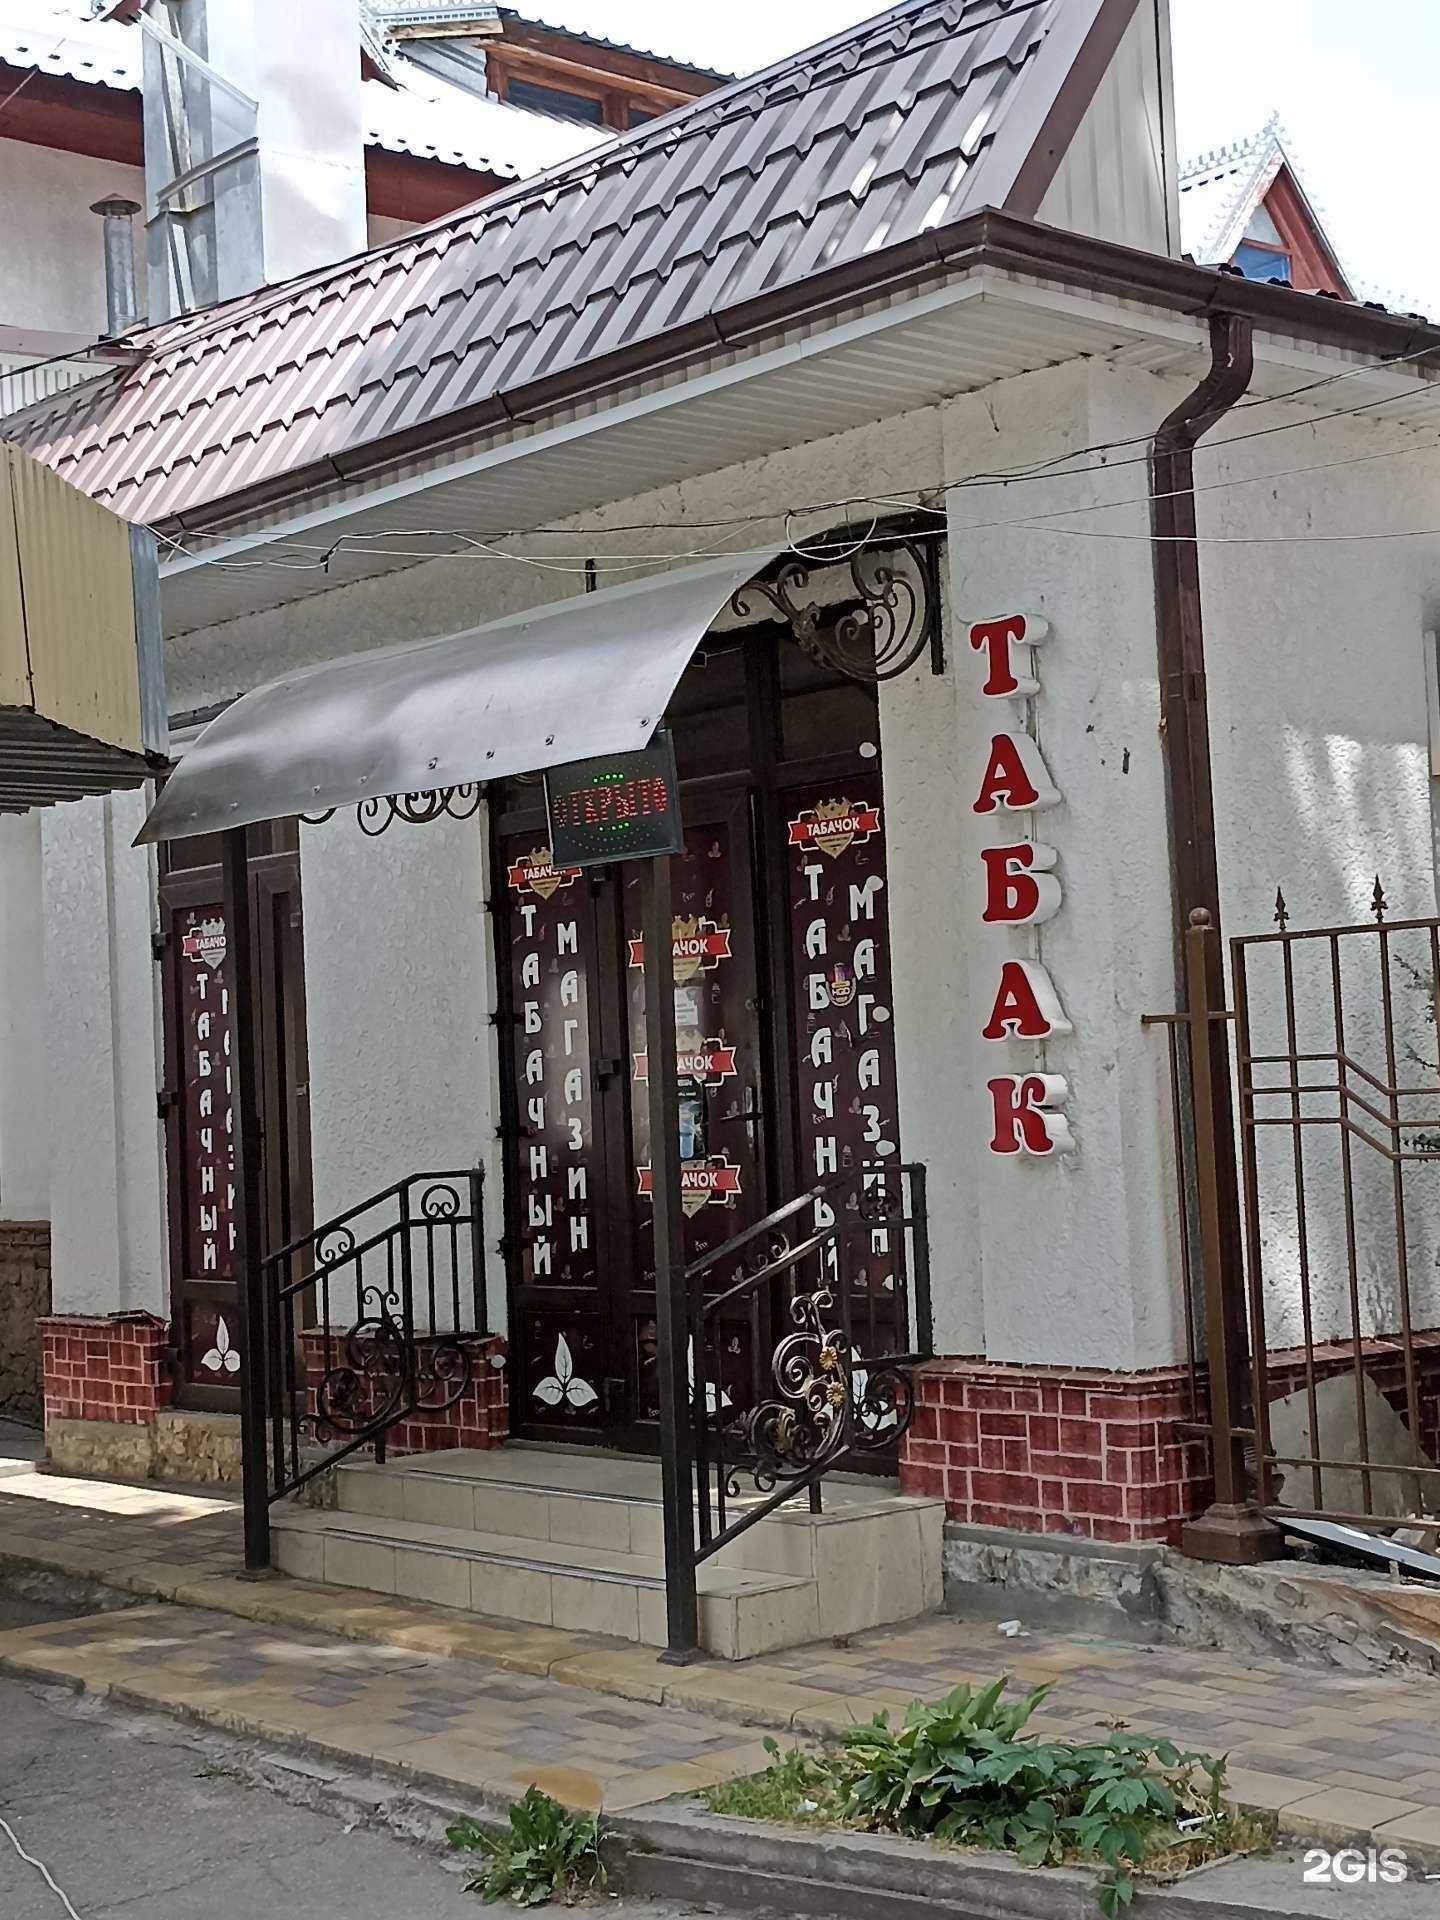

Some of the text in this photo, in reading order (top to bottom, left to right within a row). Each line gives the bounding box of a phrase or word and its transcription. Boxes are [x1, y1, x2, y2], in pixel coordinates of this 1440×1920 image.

[553, 776, 668, 828] ОТКРЫТО
[806, 816, 861, 837] ТАБАЧОК
[522, 865, 567, 880] ТАБАЧ
[968, 613, 1056, 1157] ТАБАК
[195, 935, 227, 950] ТАБАЧО
[672, 938, 709, 956] АЧОК
[677, 1054, 714, 1072] АЧОК
[520, 904, 553, 1275] ТАБАЧНЫЙ
[556, 921, 589, 1253] МАГАЗИН
[195, 973, 218, 1272] ТАБАЧНЫЙ
[681, 1170, 719, 1188] АЧОК
